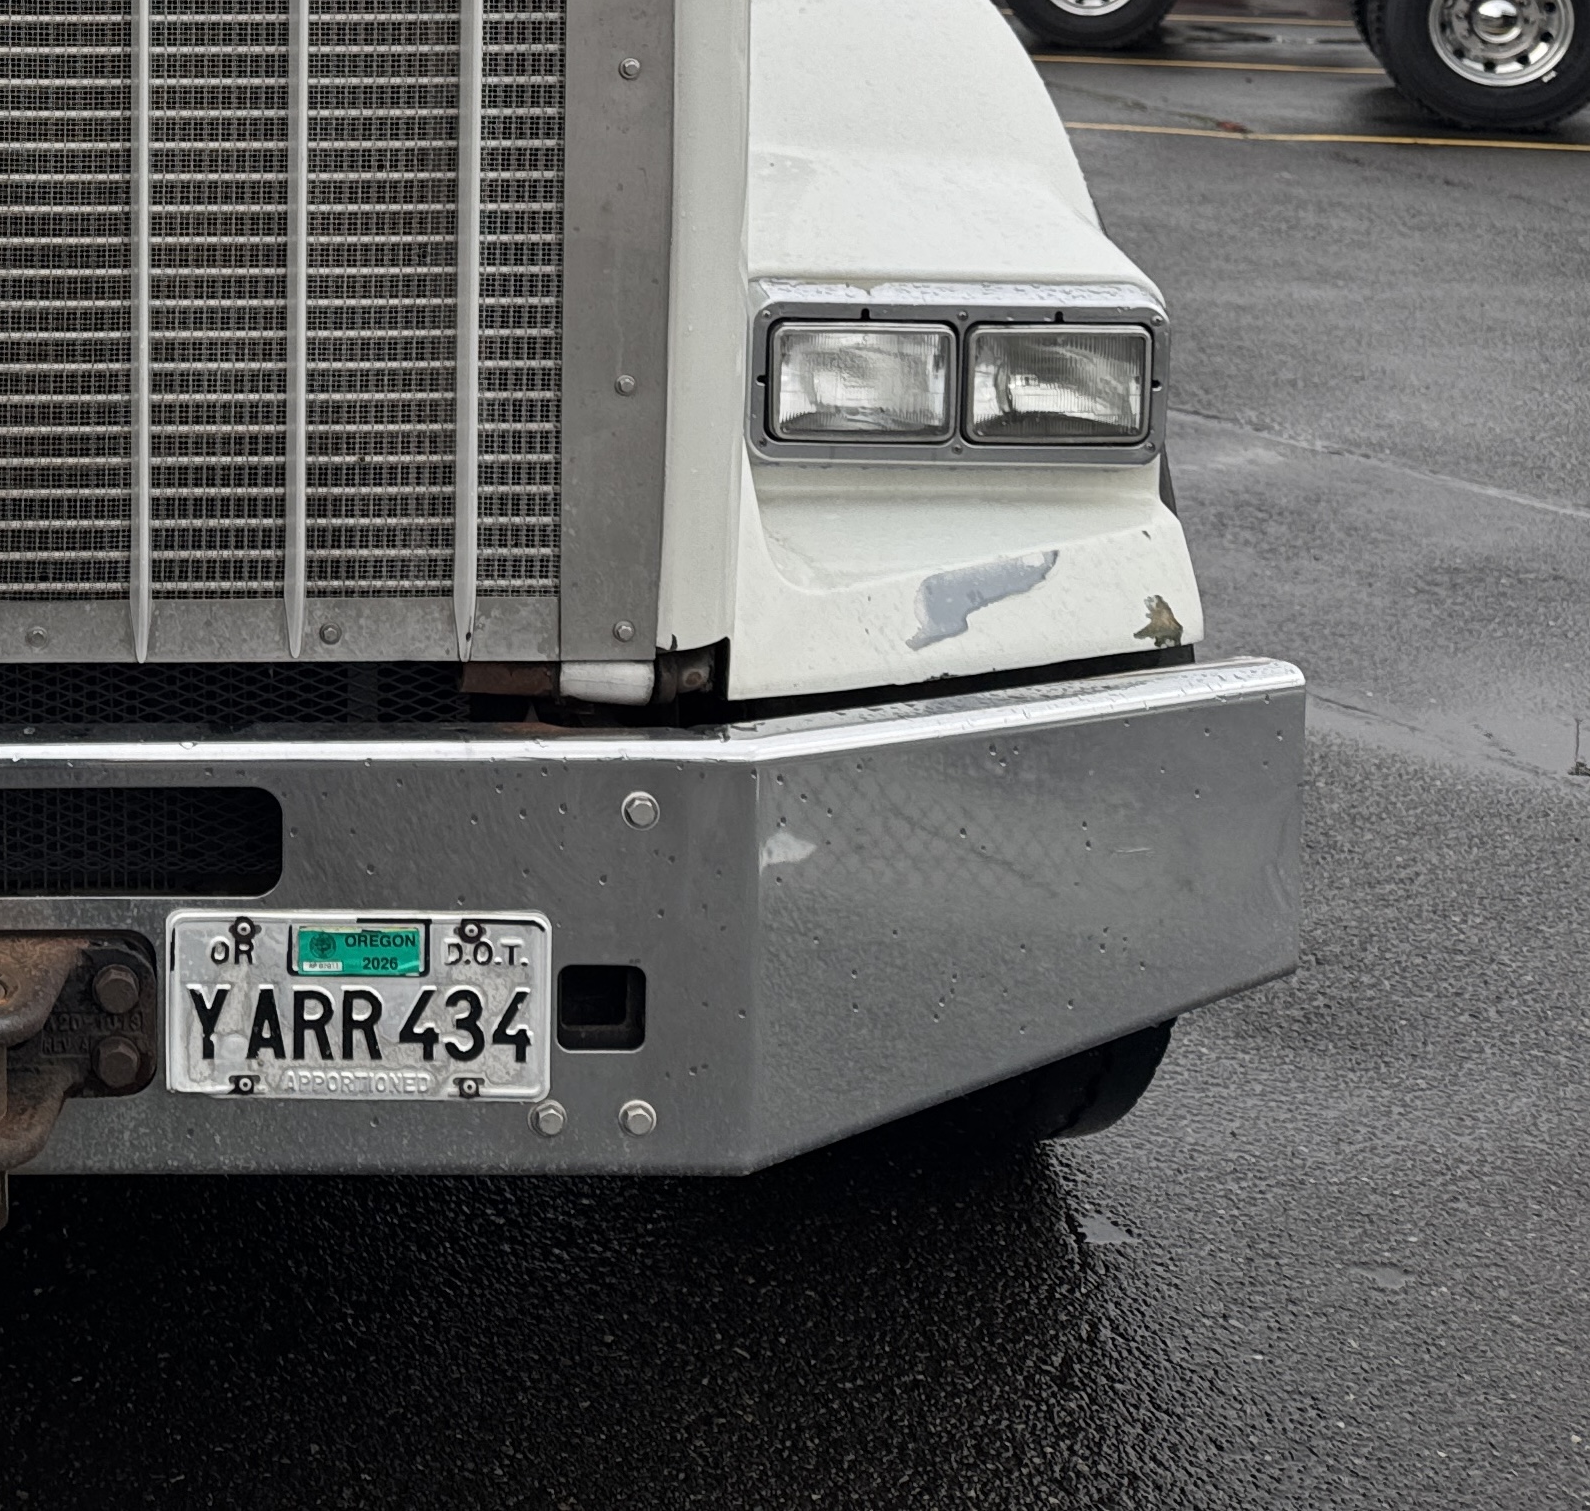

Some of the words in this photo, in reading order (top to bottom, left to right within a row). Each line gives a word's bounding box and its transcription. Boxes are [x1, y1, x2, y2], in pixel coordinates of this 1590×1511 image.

[209, 936, 254, 965] OR
[344, 934, 416, 948] OREGON
[362, 956, 399, 970] 2026
[398, 984, 533, 1064] 434
[282, 1069, 431, 1094] APPORTIONED
